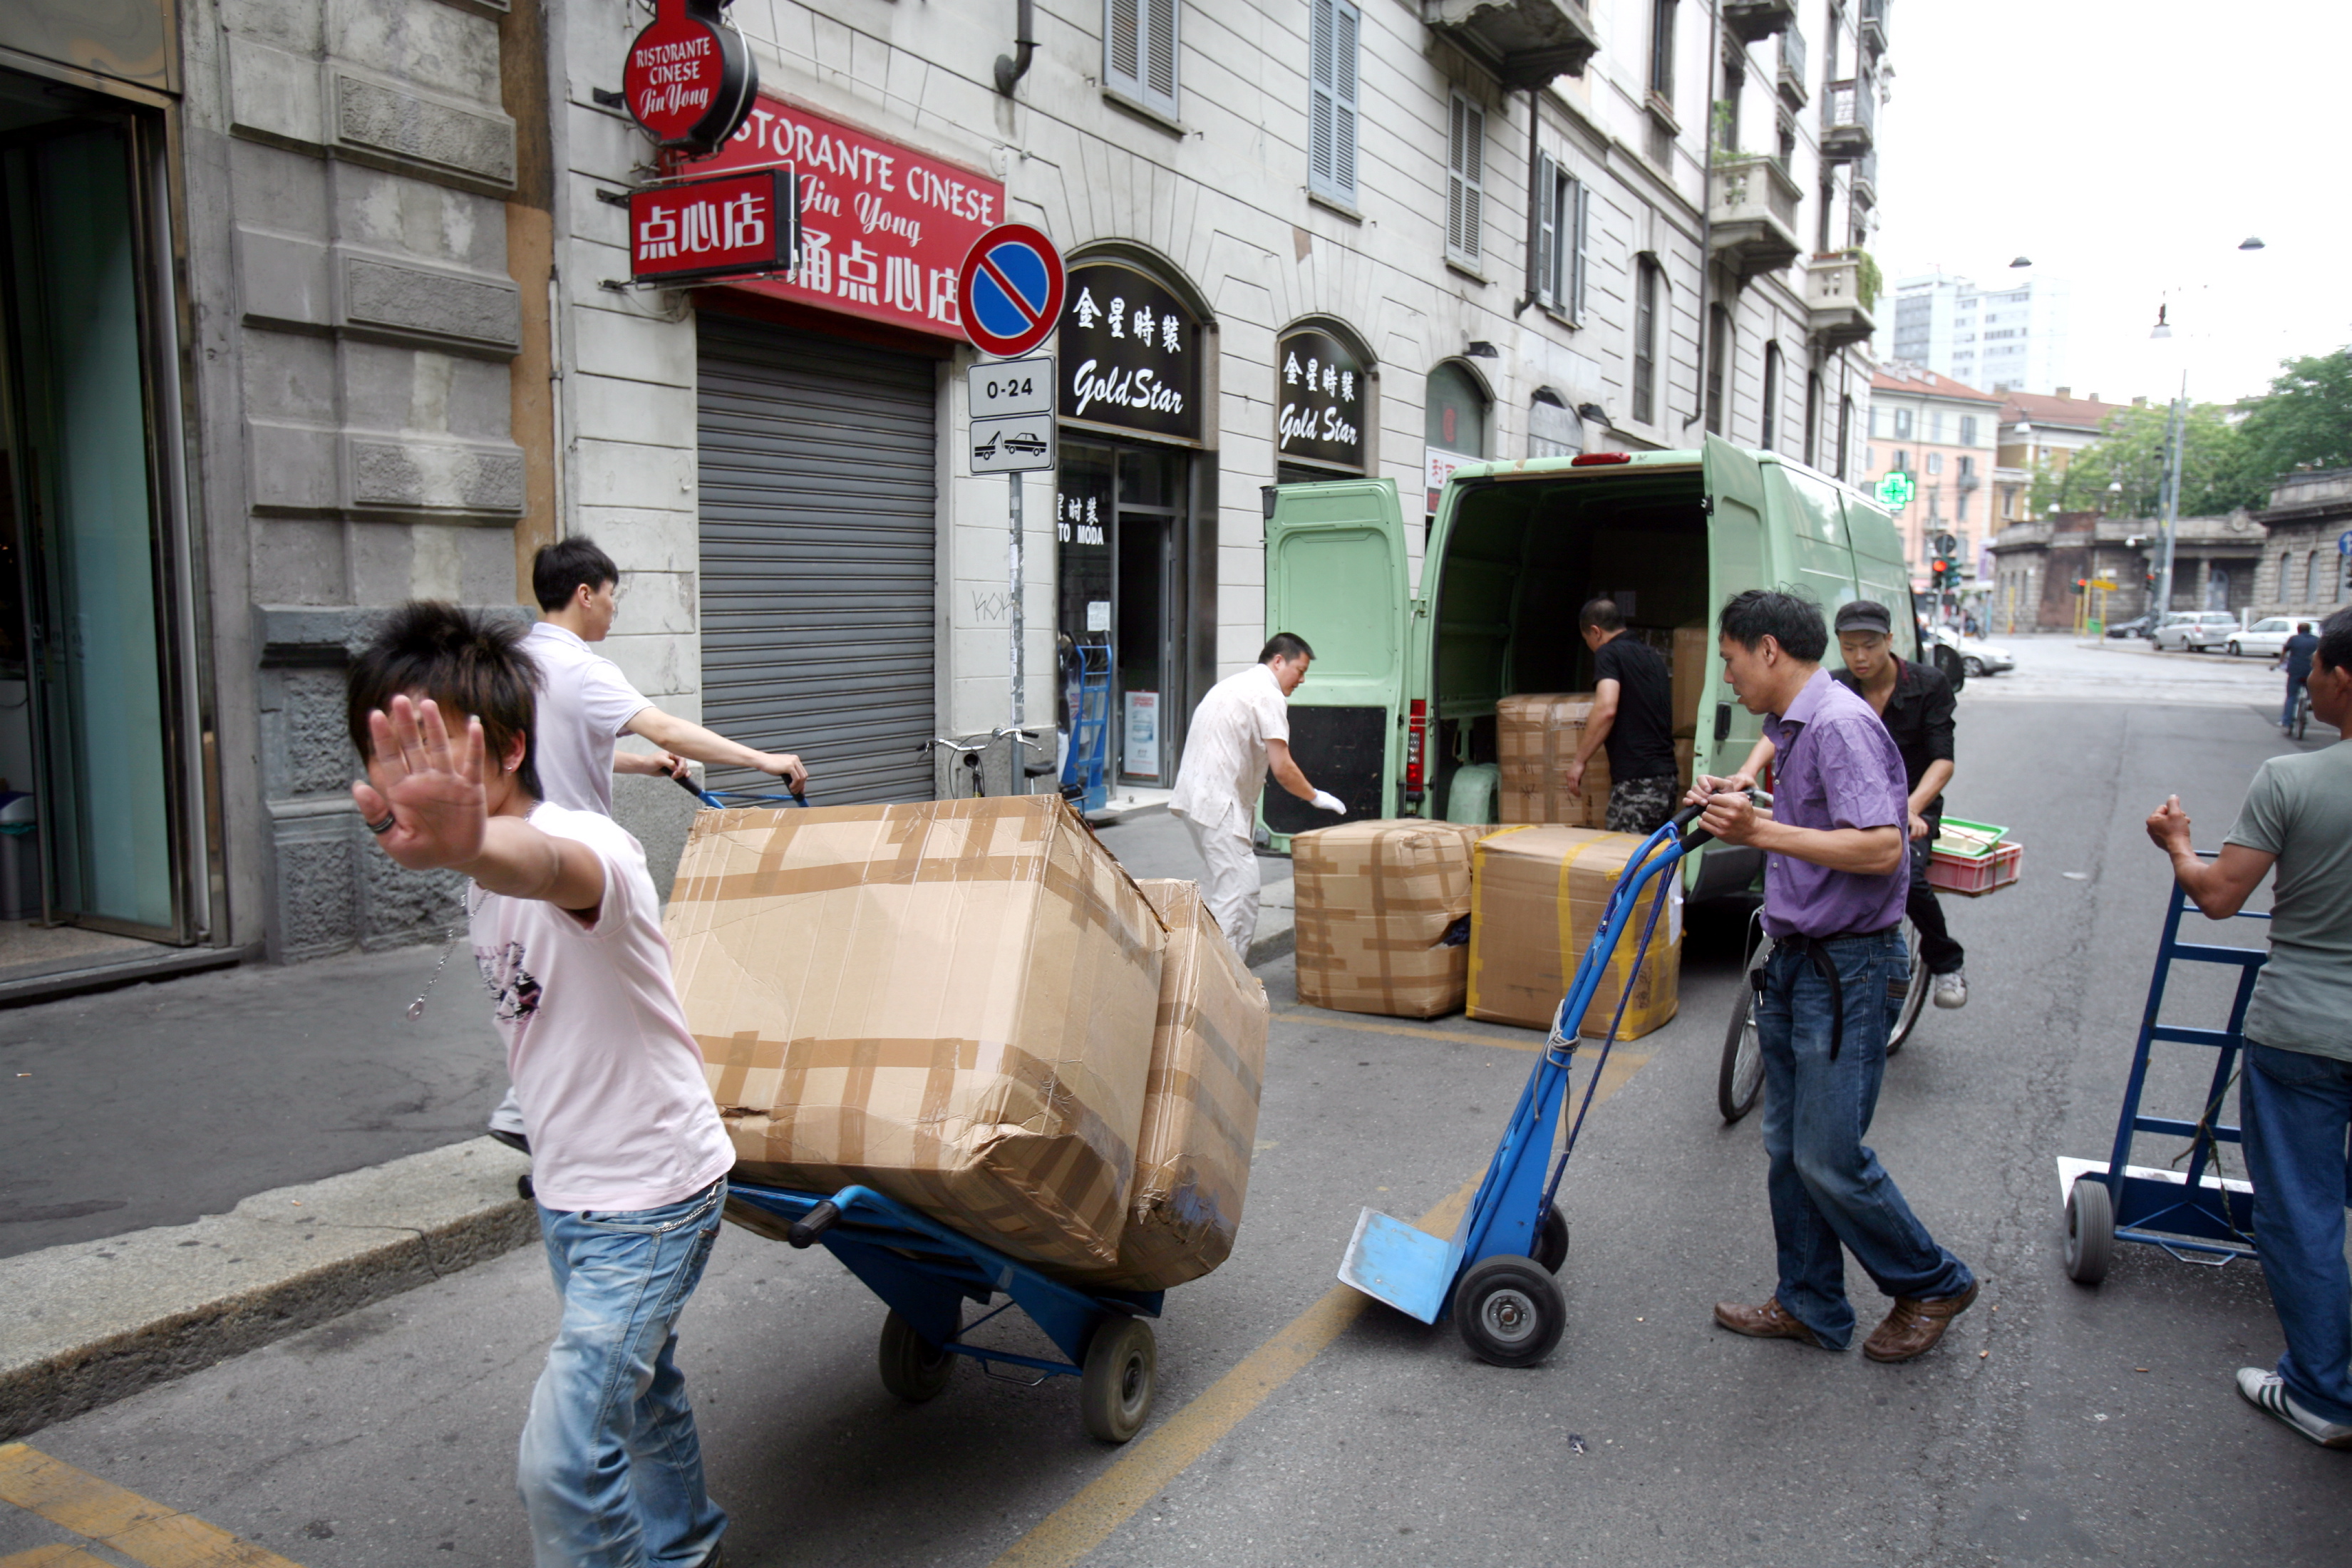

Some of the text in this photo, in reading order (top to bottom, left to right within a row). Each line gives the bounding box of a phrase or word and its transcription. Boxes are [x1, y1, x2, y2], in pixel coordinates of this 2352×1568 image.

[636, 36, 711, 68] RISTORANTE
[649, 60, 701, 85] CINESE
[640, 83, 709, 120] Jin Yong
[801, 175, 923, 248] Jin Yong
[907, 166, 995, 227] CINESE
[639, 192, 765, 261] 点心店
[986, 378, 1033, 400] 0-24
[1073, 359, 1184, 416] Gold Star
[1279, 403, 1358, 450] Gold Star
[1077, 525, 1105, 545] MODA
